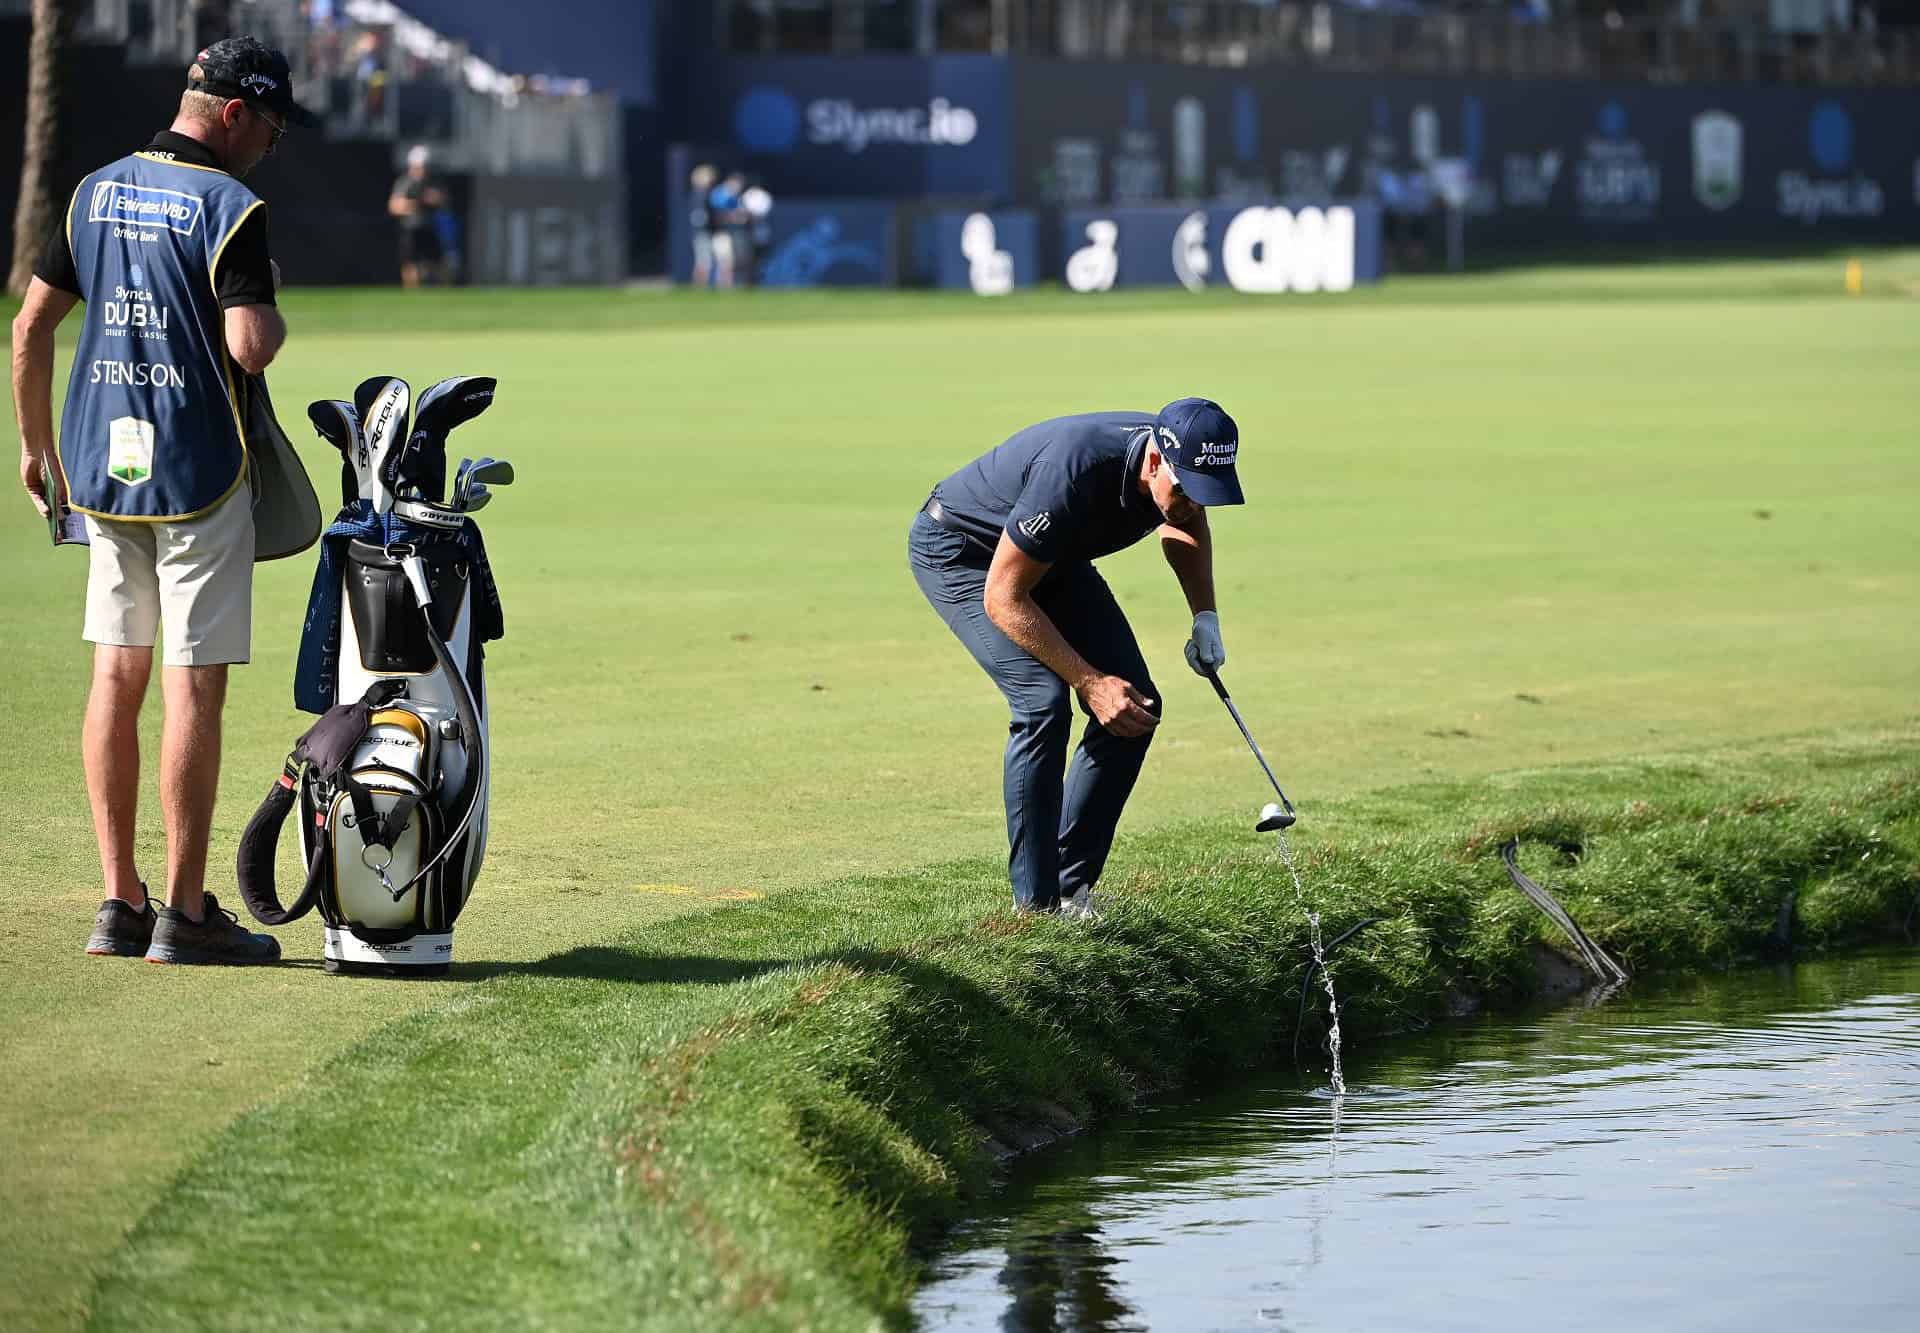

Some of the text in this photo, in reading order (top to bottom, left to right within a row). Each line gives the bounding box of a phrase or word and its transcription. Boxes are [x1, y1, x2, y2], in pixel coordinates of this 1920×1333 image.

[807, 97, 977, 153] Slync.io
[160, 200, 191, 221] NBD
[1222, 206, 1355, 293] CNN
[104, 301, 168, 329] DUBAI
[90, 359, 185, 388] STENSON
[370, 384, 403, 453] ROGUE
[1194, 453, 1235, 466] of Omah
[1201, 440, 1236, 454] Mutual
